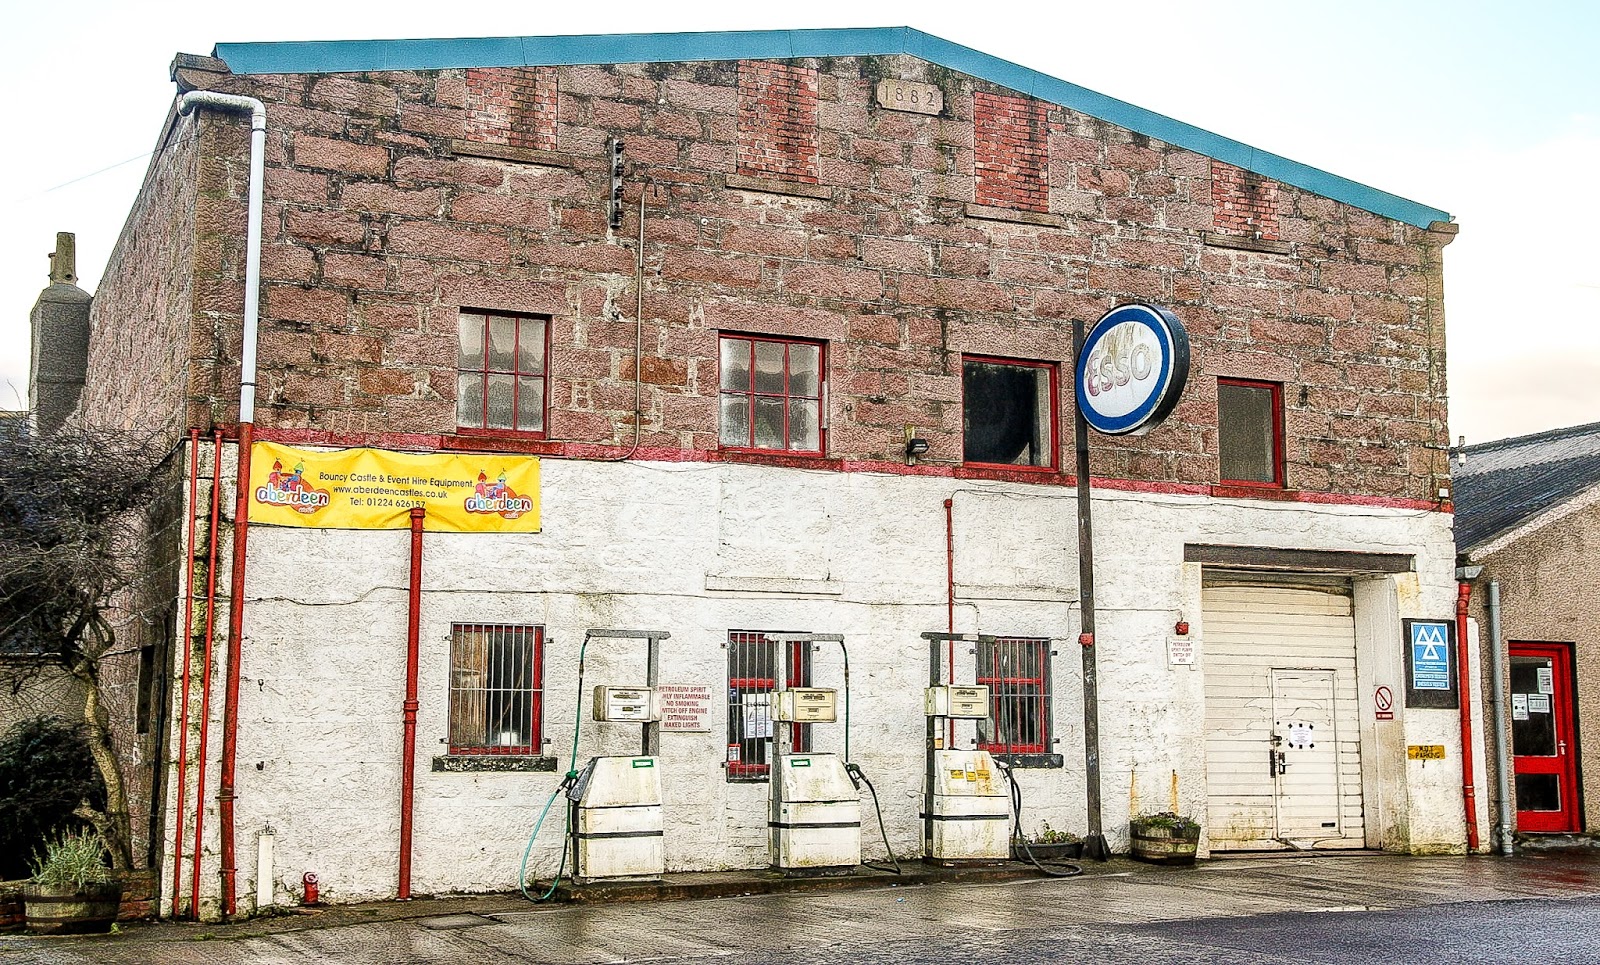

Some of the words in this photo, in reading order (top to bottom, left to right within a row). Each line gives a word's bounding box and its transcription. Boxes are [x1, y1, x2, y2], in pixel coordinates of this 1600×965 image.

[885, 85, 935, 107] 1882
[319, 472, 348, 482] Bouncy
[350, 473, 377, 482] Castle
[387, 475, 410, 484] Event
[412, 476, 428, 485] Hire
[430, 478, 475, 488] Equipment.
[257, 483, 329, 505] aberdeen
[333, 485, 448, 498] www.aberdeencastles.co.uk
[350, 497, 364, 506] Tel:
[366, 498, 393, 507] 01224
[395, 500, 426, 508] 626157
[467, 492, 532, 511] aberdeen
